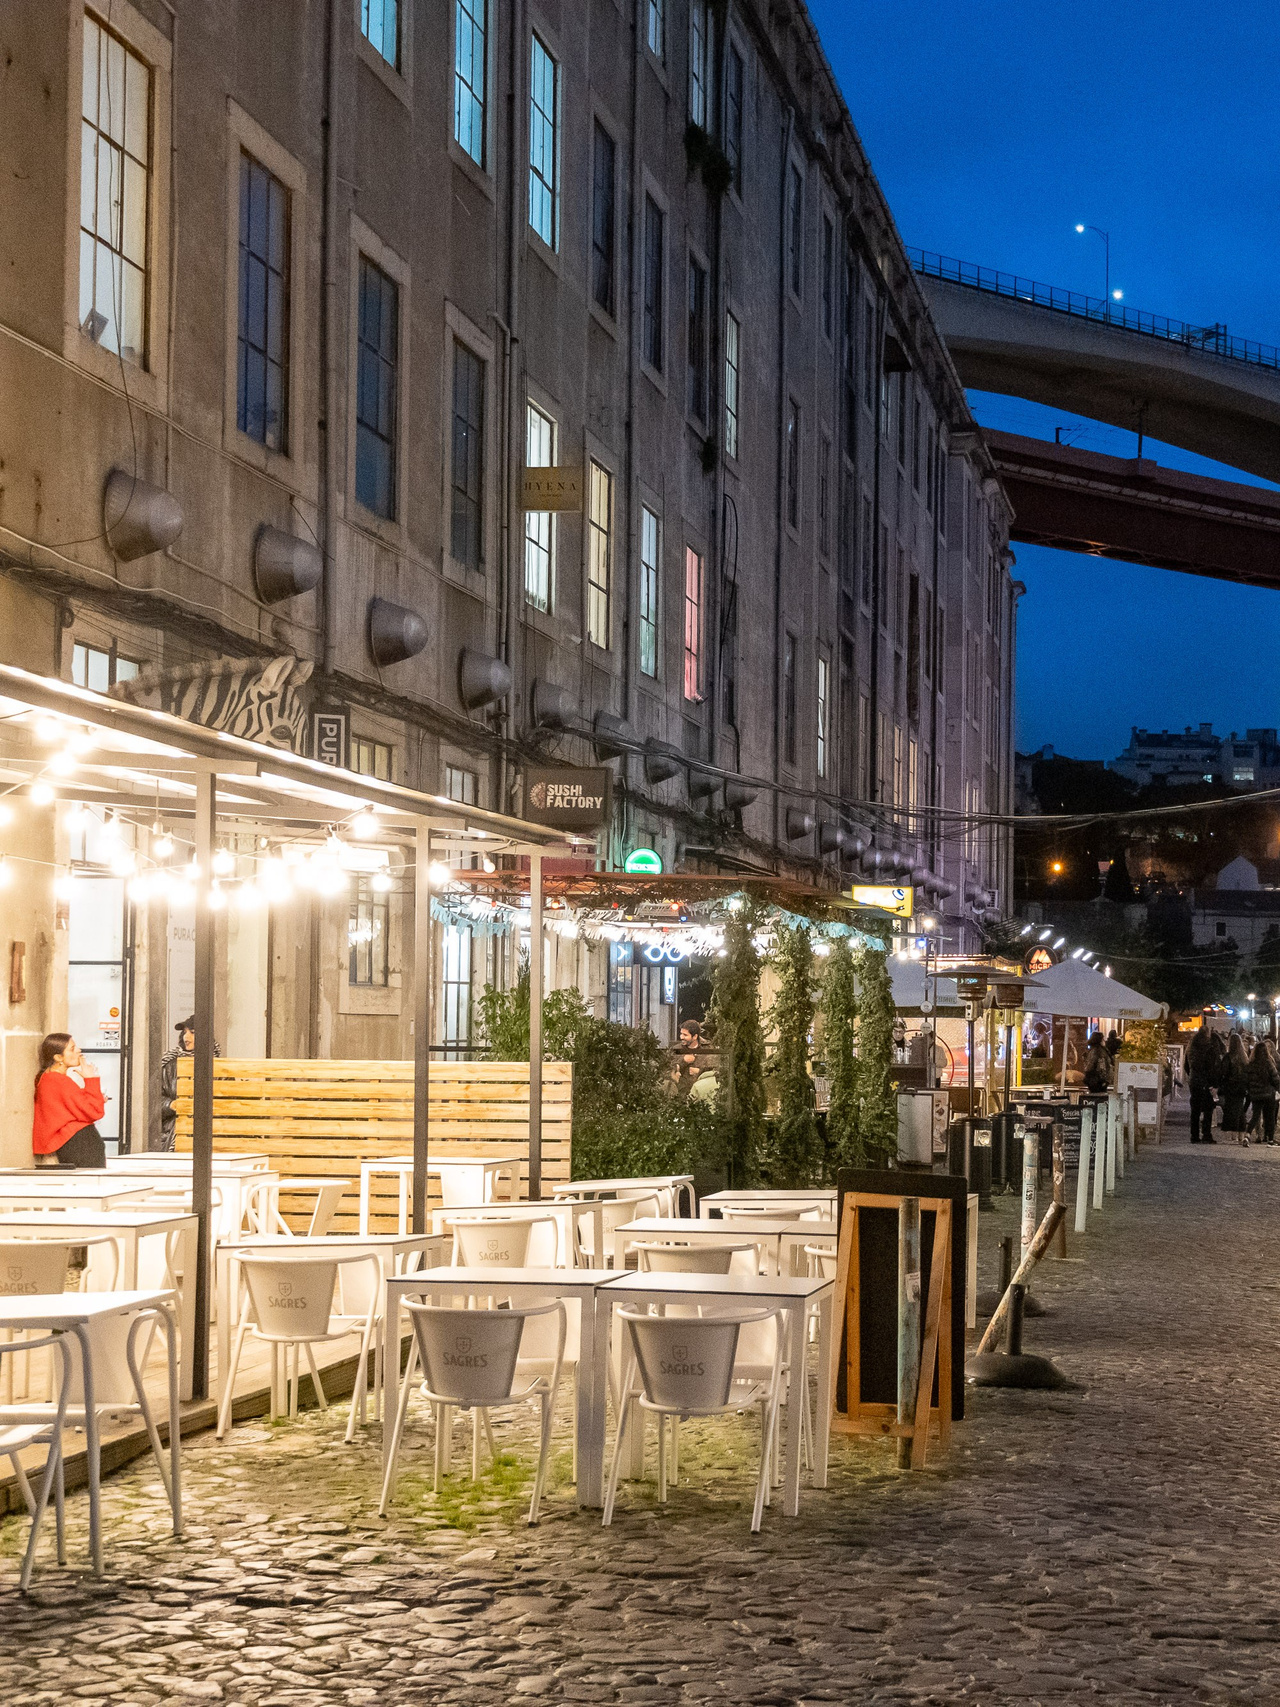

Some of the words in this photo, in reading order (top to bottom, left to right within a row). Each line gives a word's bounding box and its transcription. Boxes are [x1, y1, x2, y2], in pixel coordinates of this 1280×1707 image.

[525, 482, 576, 491] HYENA
[547, 784, 582, 796] SUSHI
[547, 796, 603, 809] FACTORY
[479, 1251, 509, 1261] SAGRES
[268, 1296, 307, 1309] SAGRES
[443, 1352, 487, 1368] SAGRES
[660, 1361, 704, 1376] SAGRES
